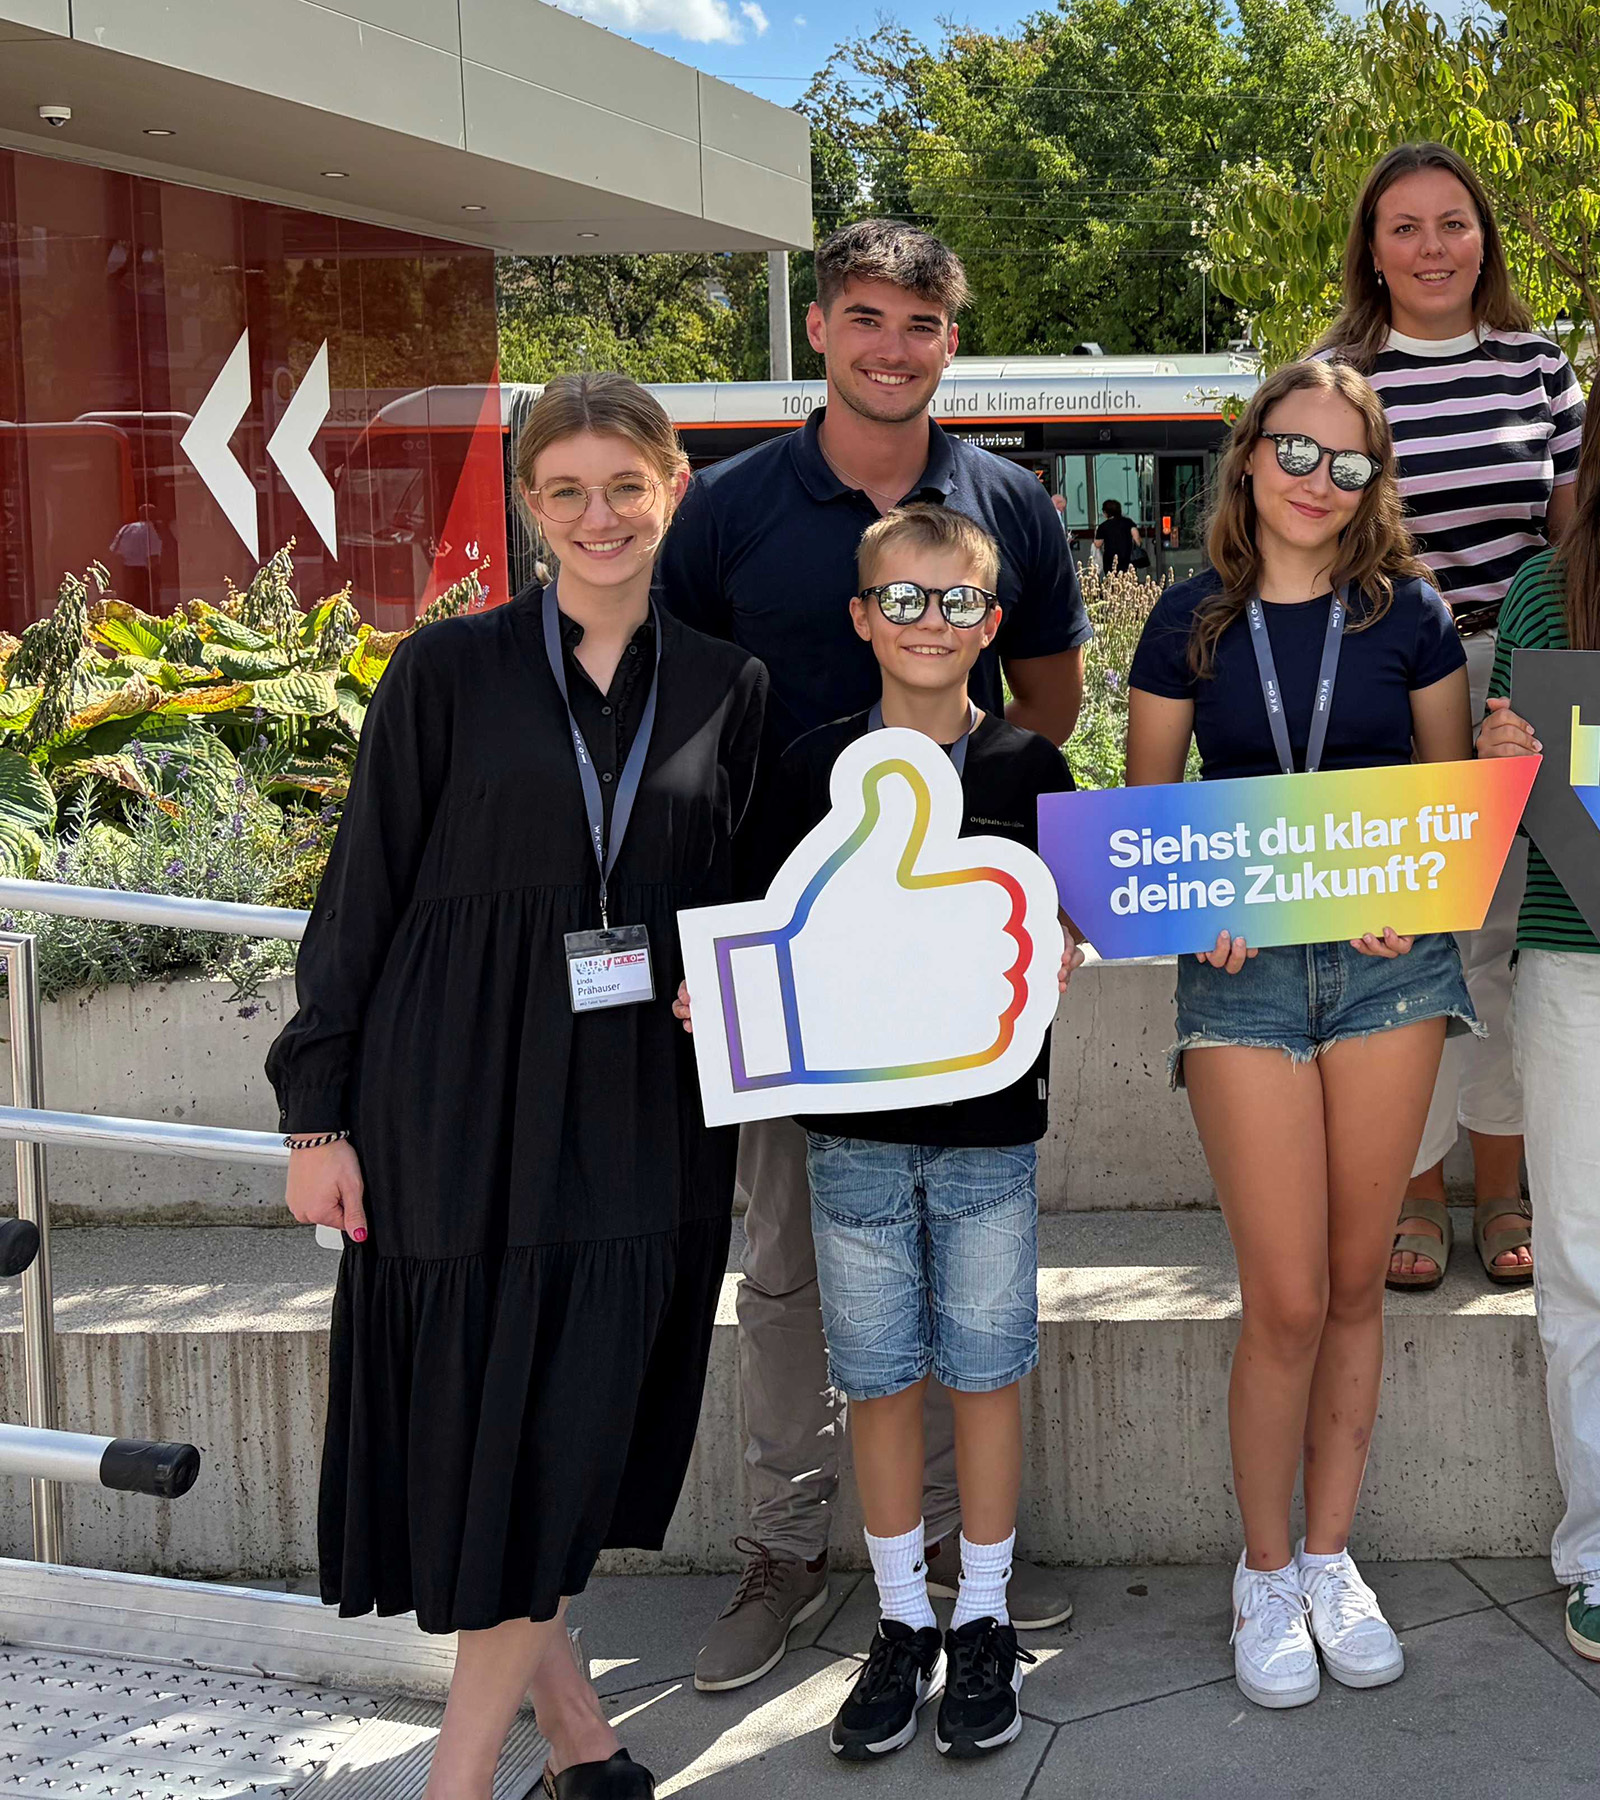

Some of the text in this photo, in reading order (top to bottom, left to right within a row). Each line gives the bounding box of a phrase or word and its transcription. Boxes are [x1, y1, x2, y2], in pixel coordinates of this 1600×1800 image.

[782, 396, 813, 414] 100
[943, 395, 978, 412] und
[987, 391, 1142, 411] klimafreundlich.
[1108, 804, 1479, 868] Siehst du klar für
[1109, 851, 1446, 915] deine Zukunft?
[577, 977, 592, 985] Linda
[577, 983, 620, 996] Prähauser
